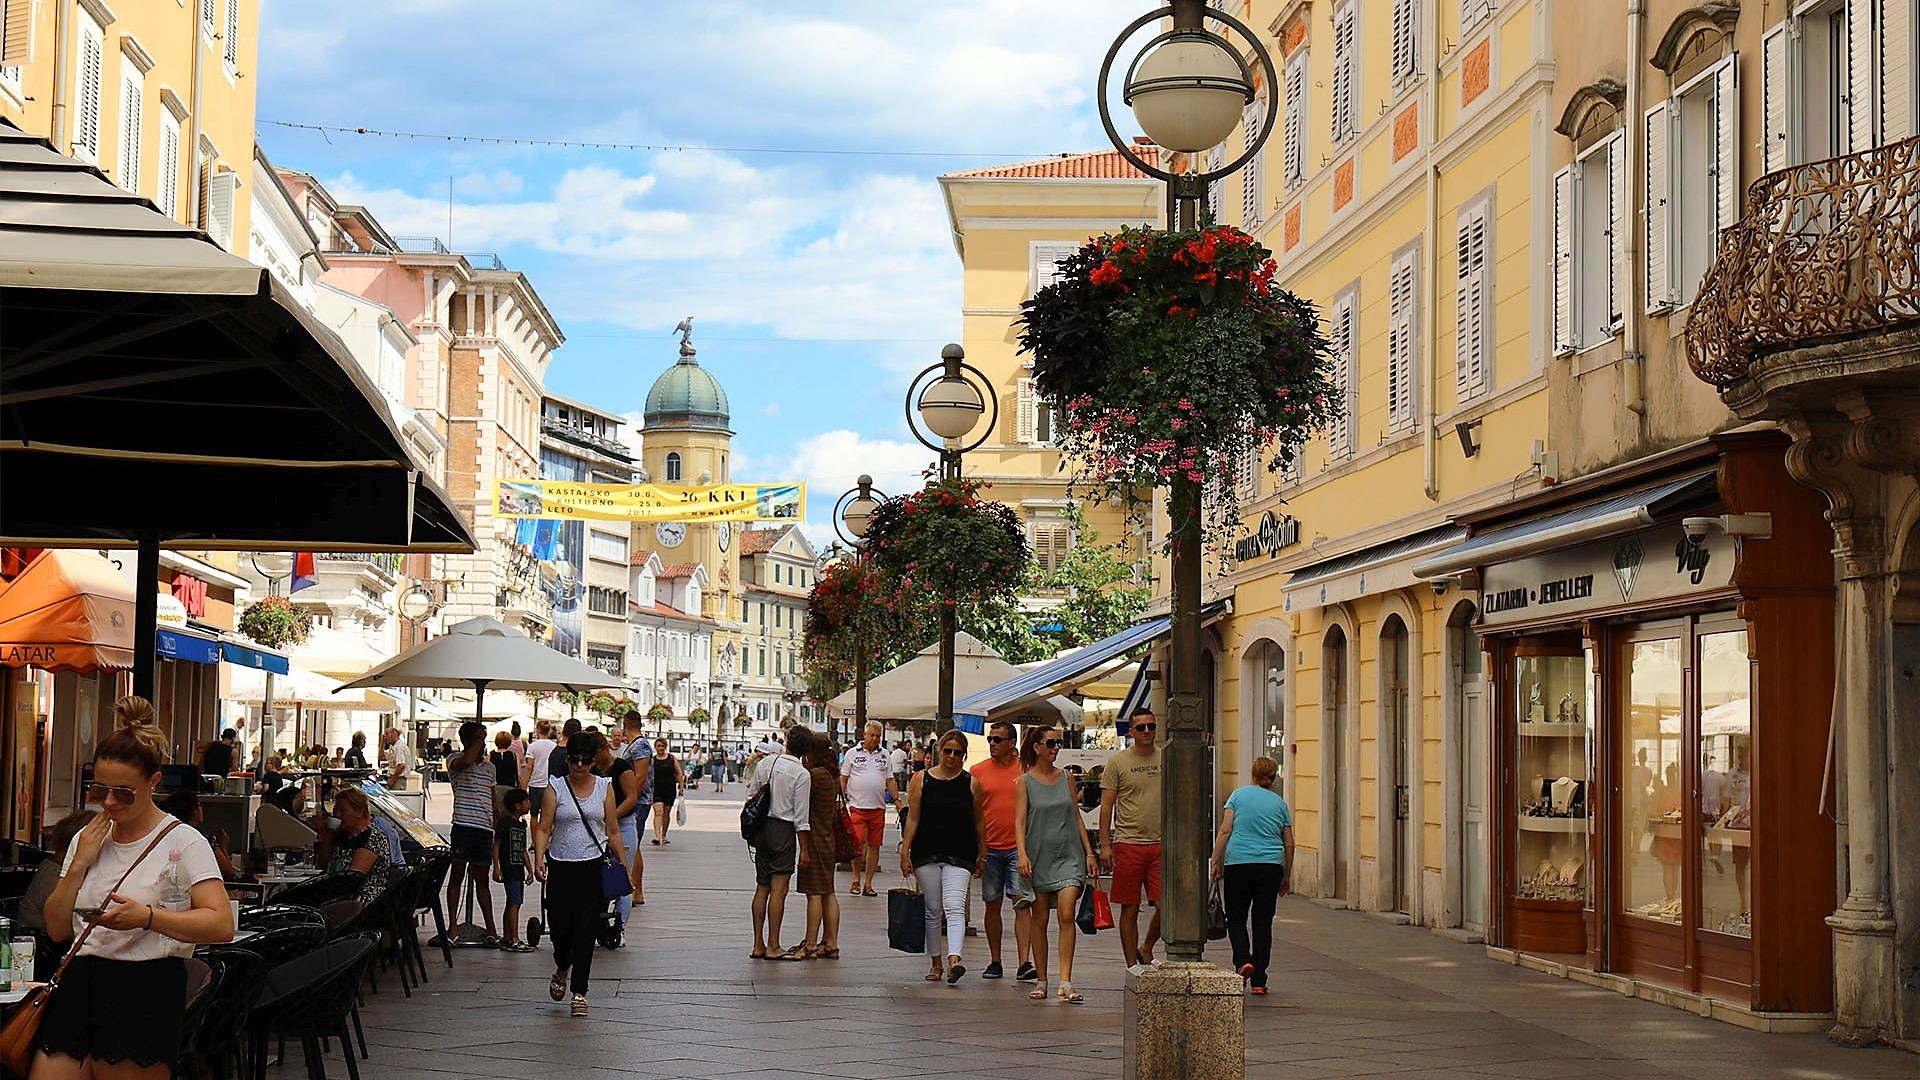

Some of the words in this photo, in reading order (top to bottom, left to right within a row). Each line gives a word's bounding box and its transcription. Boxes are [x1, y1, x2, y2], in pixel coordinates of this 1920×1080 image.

[556, 498, 614, 506] KULTURNO
[1485, 587, 1528, 614] ZLATARNA
[1538, 575, 1594, 605] JEWELLERY
[0, 646, 56, 661] LATAR
